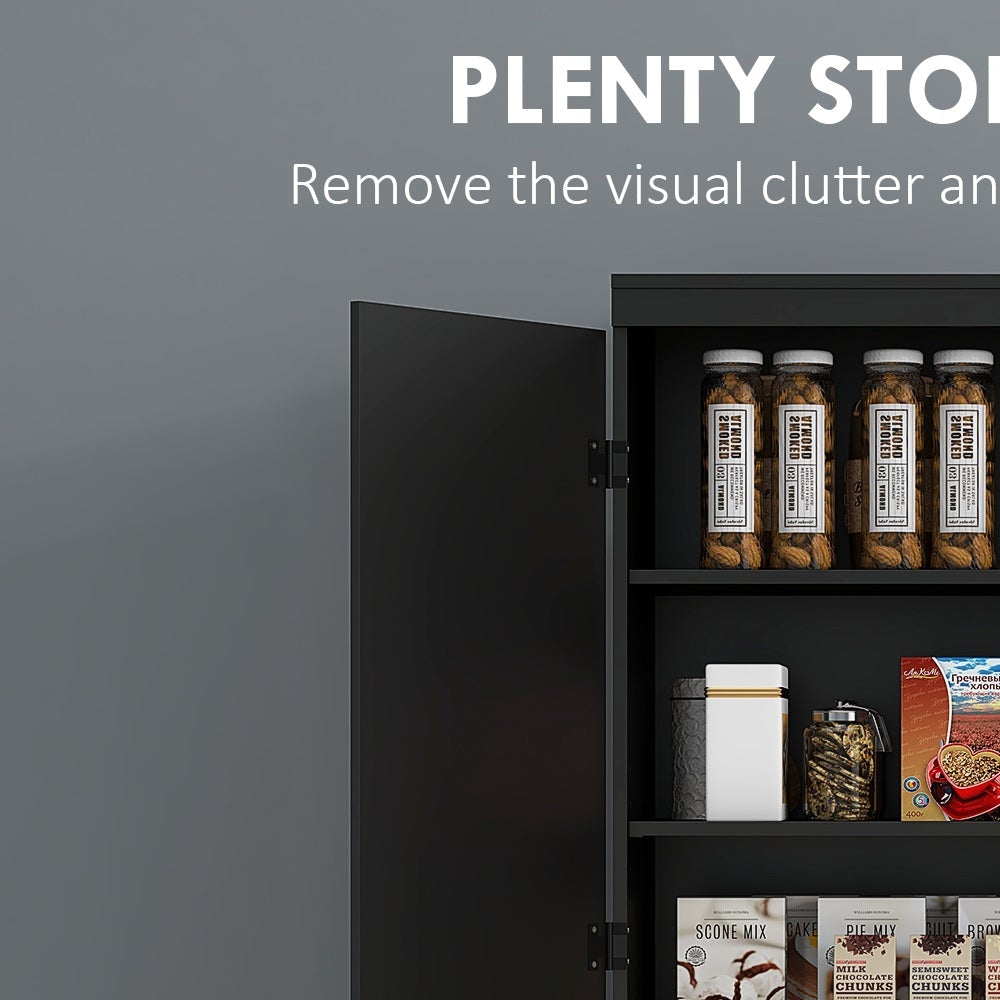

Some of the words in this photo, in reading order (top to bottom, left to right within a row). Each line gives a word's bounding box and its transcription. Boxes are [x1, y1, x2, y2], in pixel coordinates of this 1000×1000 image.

[696, 924, 737, 940] SCONE
[744, 924, 767, 940] MIX
[786, 922, 818, 937] CAKE
[874, 924, 896, 937] MIX
[836, 983, 893, 991] CHUNKS
[912, 983, 969, 991] CHUNKS
